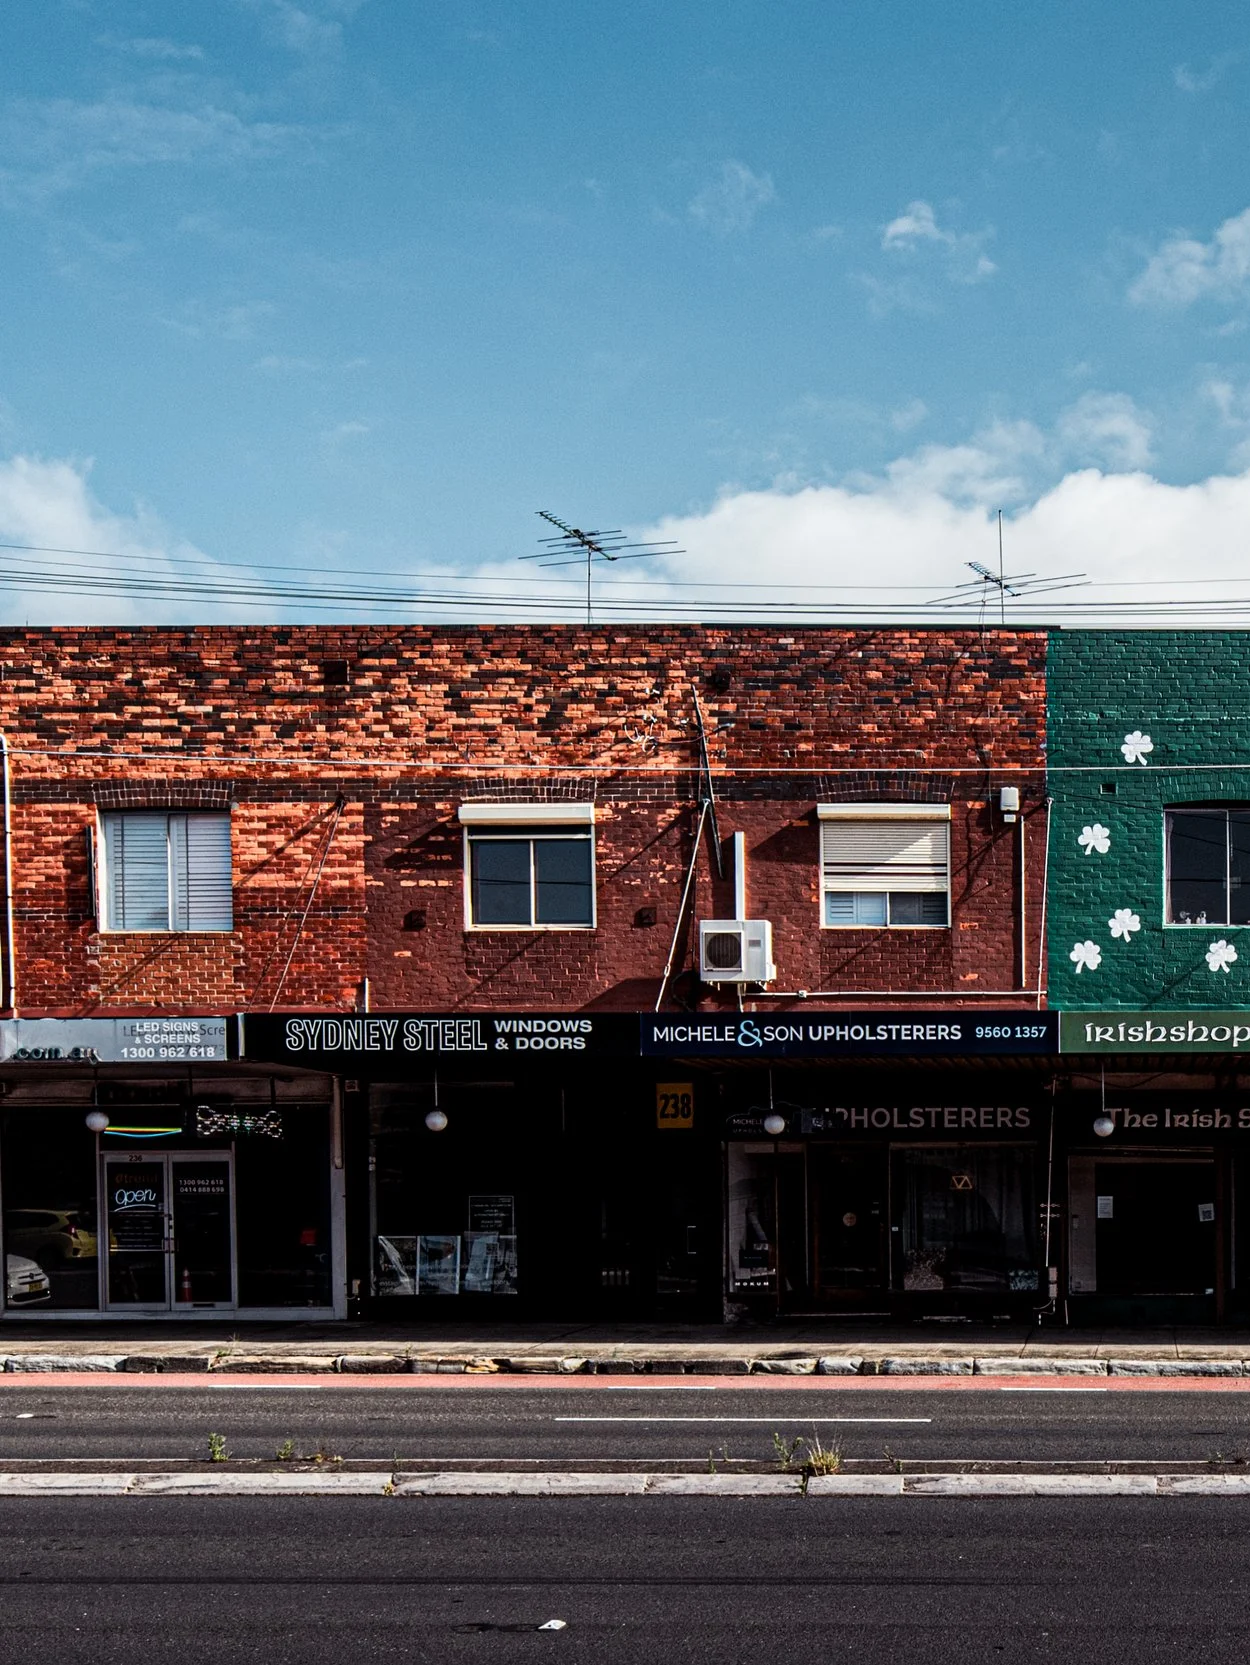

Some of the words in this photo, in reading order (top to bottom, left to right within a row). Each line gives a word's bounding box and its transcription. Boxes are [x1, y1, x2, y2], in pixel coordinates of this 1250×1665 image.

[136, 1022, 159, 1032] LED
[162, 1022, 199, 1032] SIGNS
[494, 1020, 593, 1032] WINDOWS
[144, 1034, 201, 1044] SCREENS
[286, 1019, 399, 1050] SYDNEY
[403, 1019, 487, 1050] STEEL
[653, 1026, 736, 1042] MICHELE
[737, 1020, 763, 1048] &
[763, 1025, 803, 1042] SON
[808, 1025, 962, 1041] UPHOLSTERERS
[975, 1026, 1011, 1038] 9560
[1015, 1026, 1047, 1038] 1357
[494, 1037, 509, 1050] &
[515, 1037, 587, 1050] DOORS
[121, 1047, 155, 1058] 1300
[159, 1047, 186, 1058] 962
[189, 1047, 215, 1058] 618
[660, 1094, 691, 1119] 238
[1103, 1108, 1159, 1128] The
[1165, 1108, 1232, 1129] Irish
